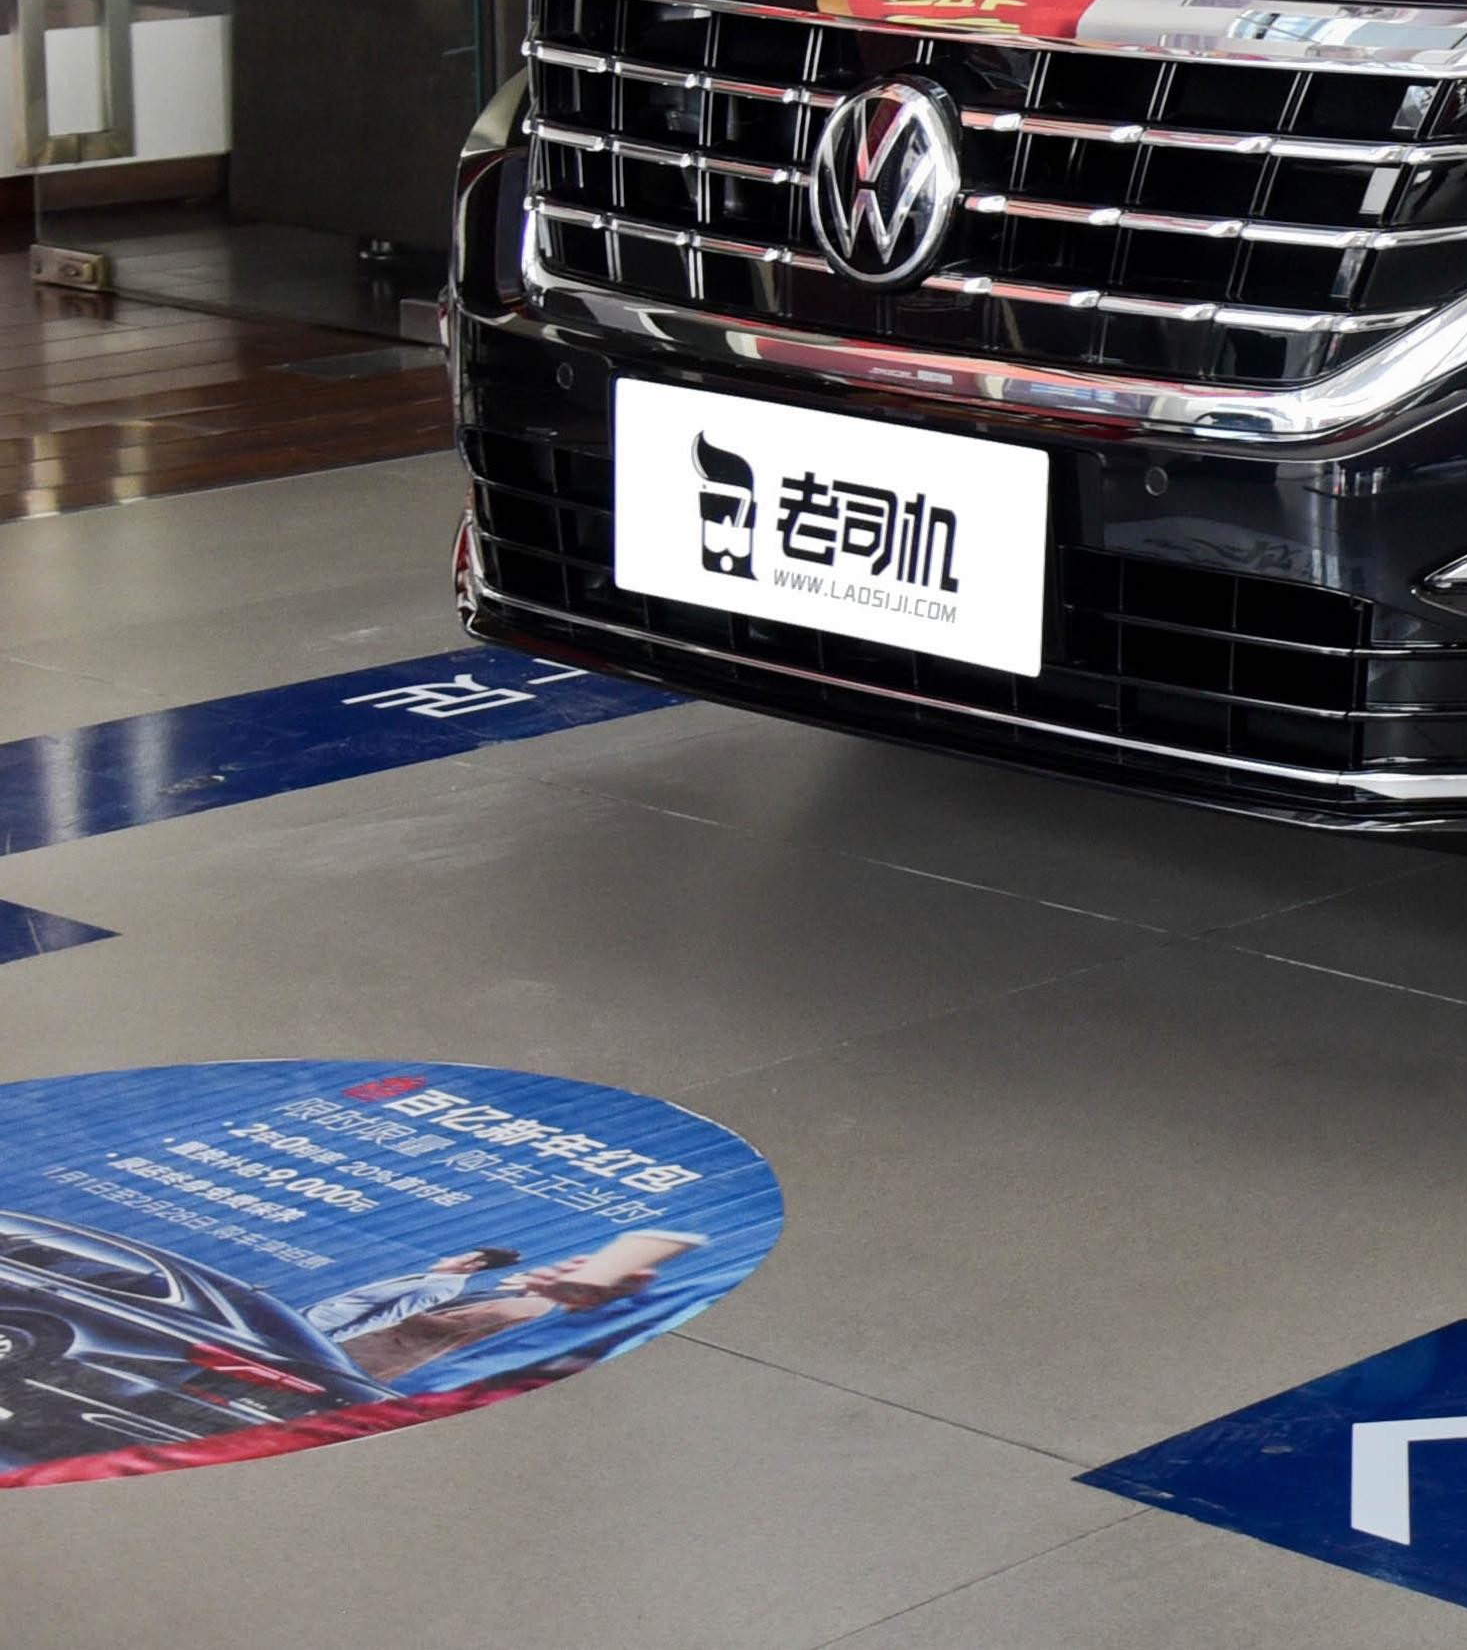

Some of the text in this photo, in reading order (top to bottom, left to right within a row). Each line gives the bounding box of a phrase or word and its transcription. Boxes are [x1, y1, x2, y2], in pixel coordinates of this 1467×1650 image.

[811, 84, 960, 283] VW
[776, 471, 960, 593] 老司机
[773, 569, 958, 624] WWW.LAOSIJI.COM
[272, 1096, 669, 1225] 限时限量 购车正当时
[335, 1160, 474, 1208] 20%首付起
[382, 1088, 704, 1194] 百亿新年红包
[42, 1165, 219, 1231] 1月1日至2月28日
